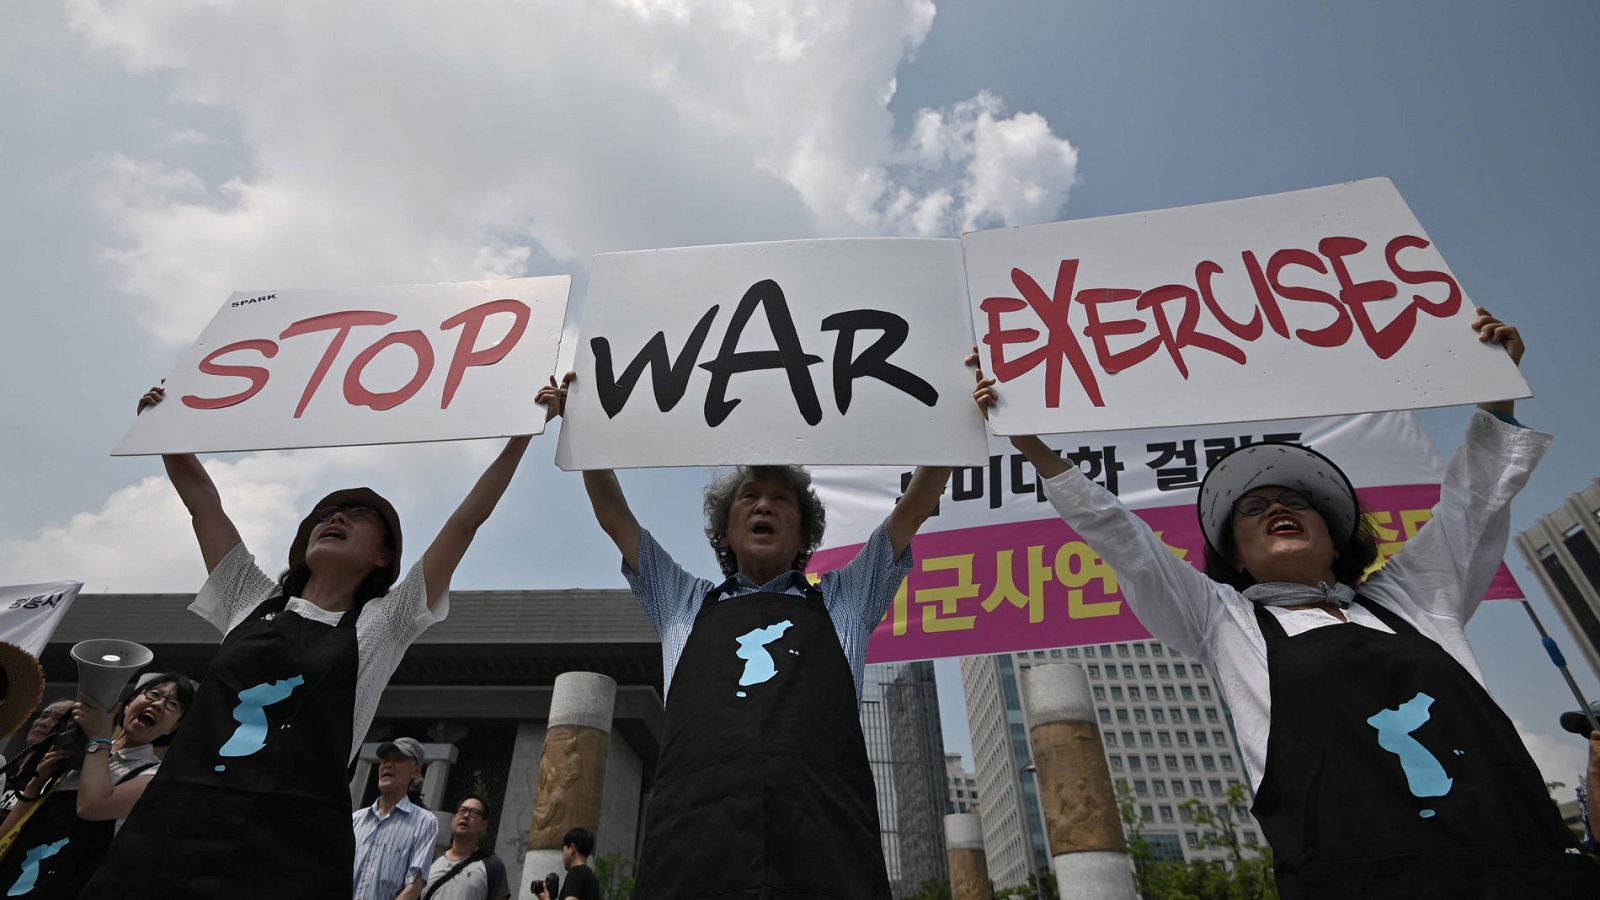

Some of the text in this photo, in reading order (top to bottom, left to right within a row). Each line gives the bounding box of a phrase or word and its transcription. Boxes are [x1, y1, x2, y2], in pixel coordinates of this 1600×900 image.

[181, 299, 531, 418] STOP
[231, 294, 277, 308] SPARK
[590, 279, 939, 428] WAR
[980, 235, 1462, 409] EXERCISES
[895, 446, 1124, 516] 미대화
